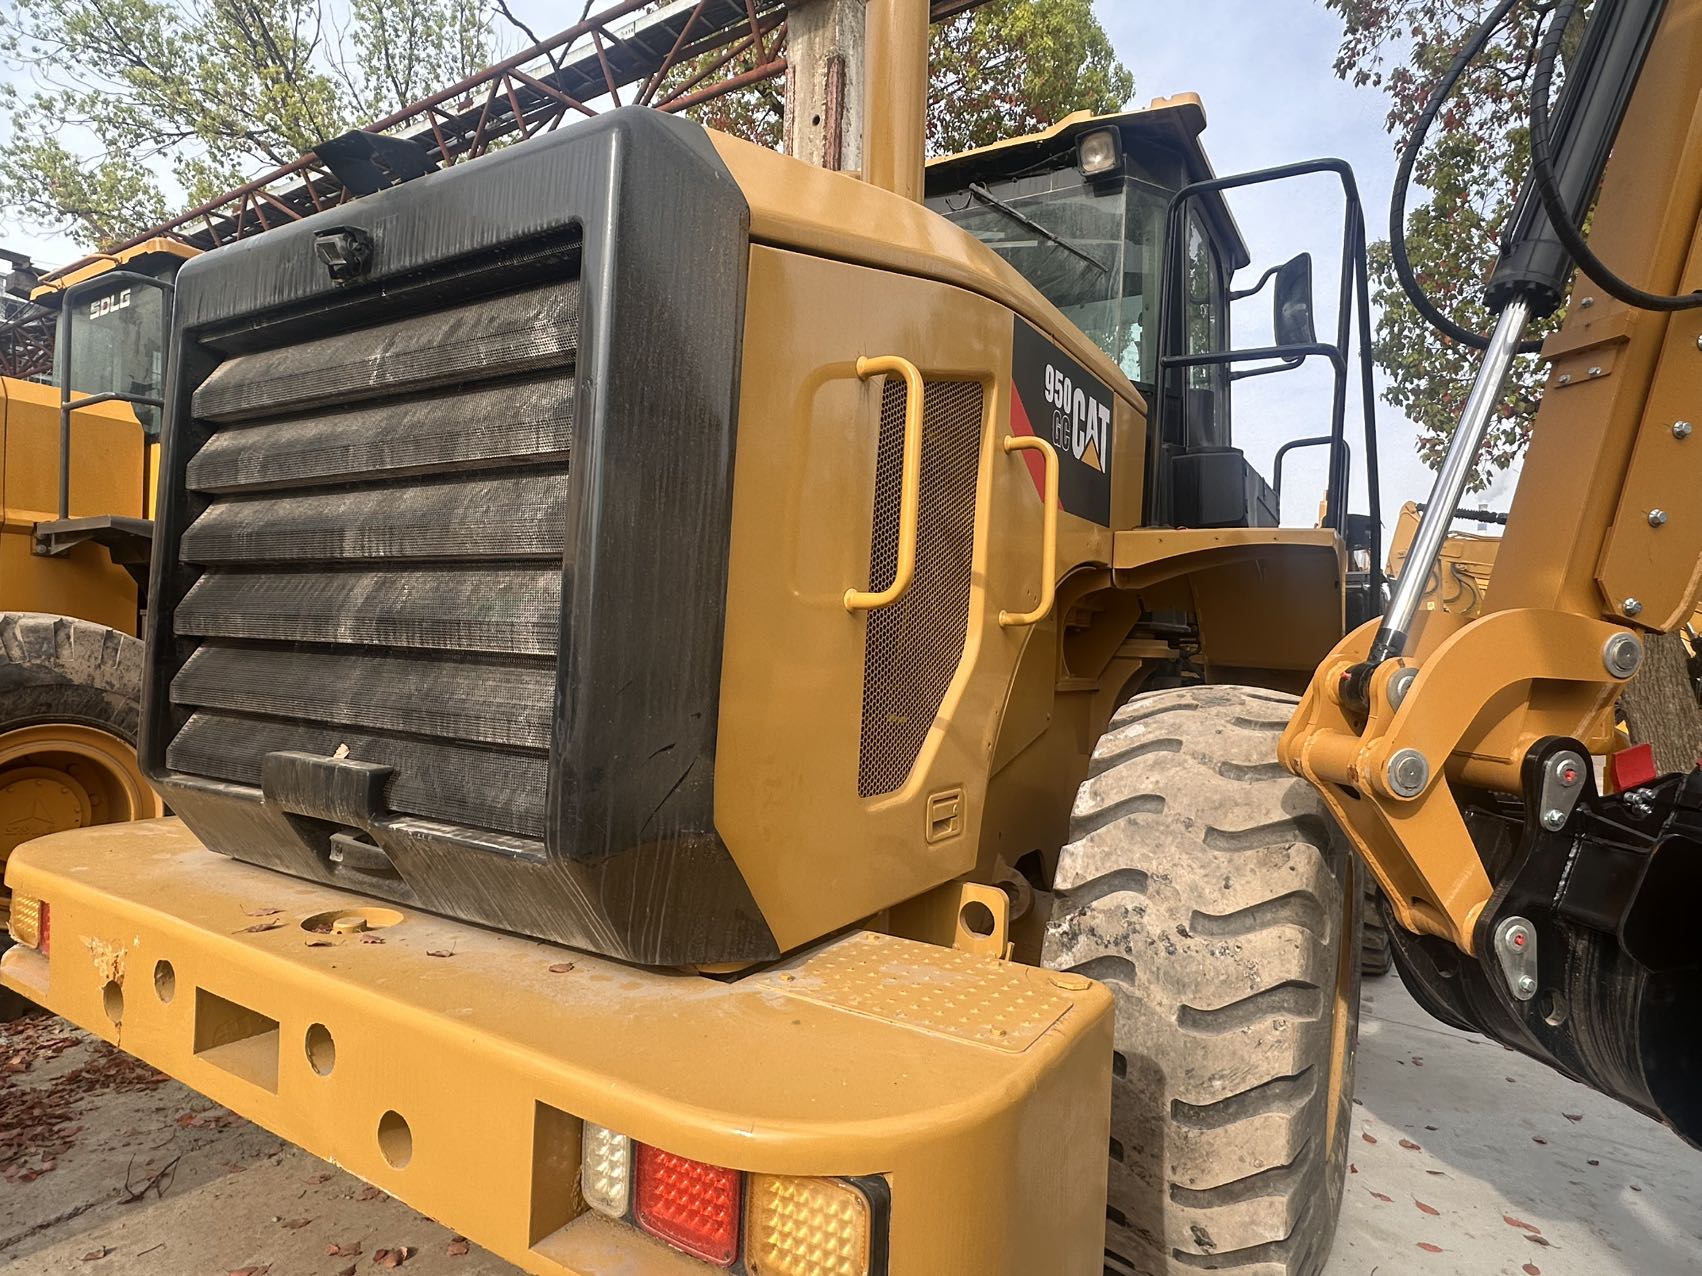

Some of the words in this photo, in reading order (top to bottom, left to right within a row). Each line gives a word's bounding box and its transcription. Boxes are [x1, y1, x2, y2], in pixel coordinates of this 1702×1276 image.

[89, 288, 131, 320] SDLG
[1045, 364, 1072, 414] 950
[1052, 409, 1071, 452] GC
[1072, 388, 1110, 474] CAT
